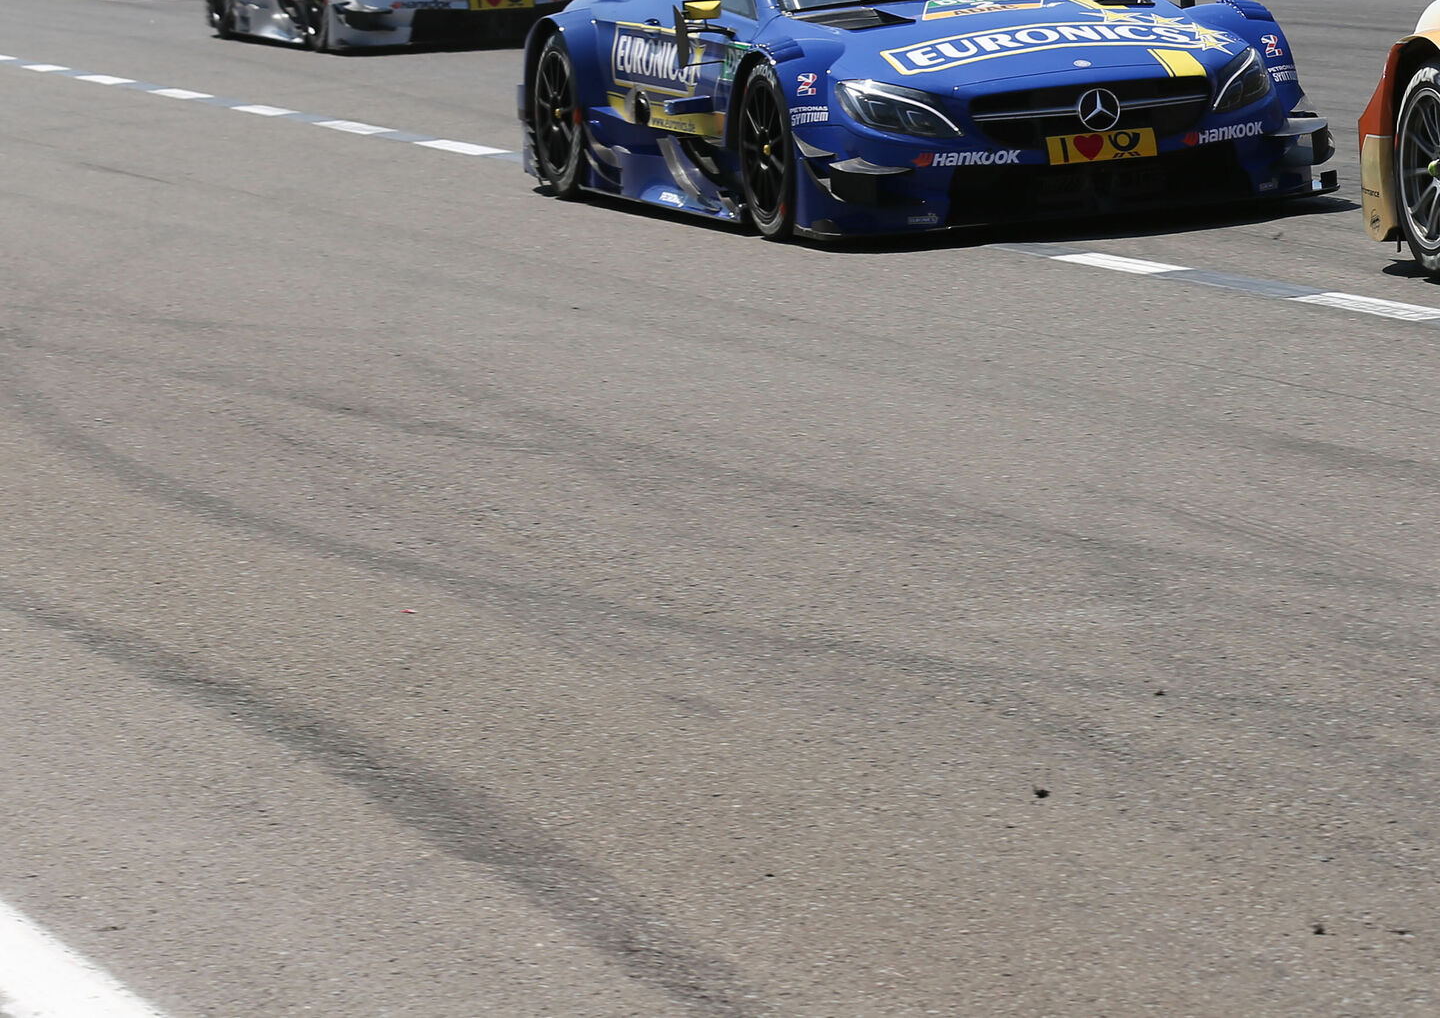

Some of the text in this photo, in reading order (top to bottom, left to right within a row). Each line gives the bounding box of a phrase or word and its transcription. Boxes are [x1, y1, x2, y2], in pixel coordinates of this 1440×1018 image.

[905, 24, 1194, 67] EURONICS
[1261, 35, 1283, 58] 2
[796, 73, 817, 96] 2
[789, 105, 828, 114] PETRONAS
[791, 111, 829, 126] SYNTIUM
